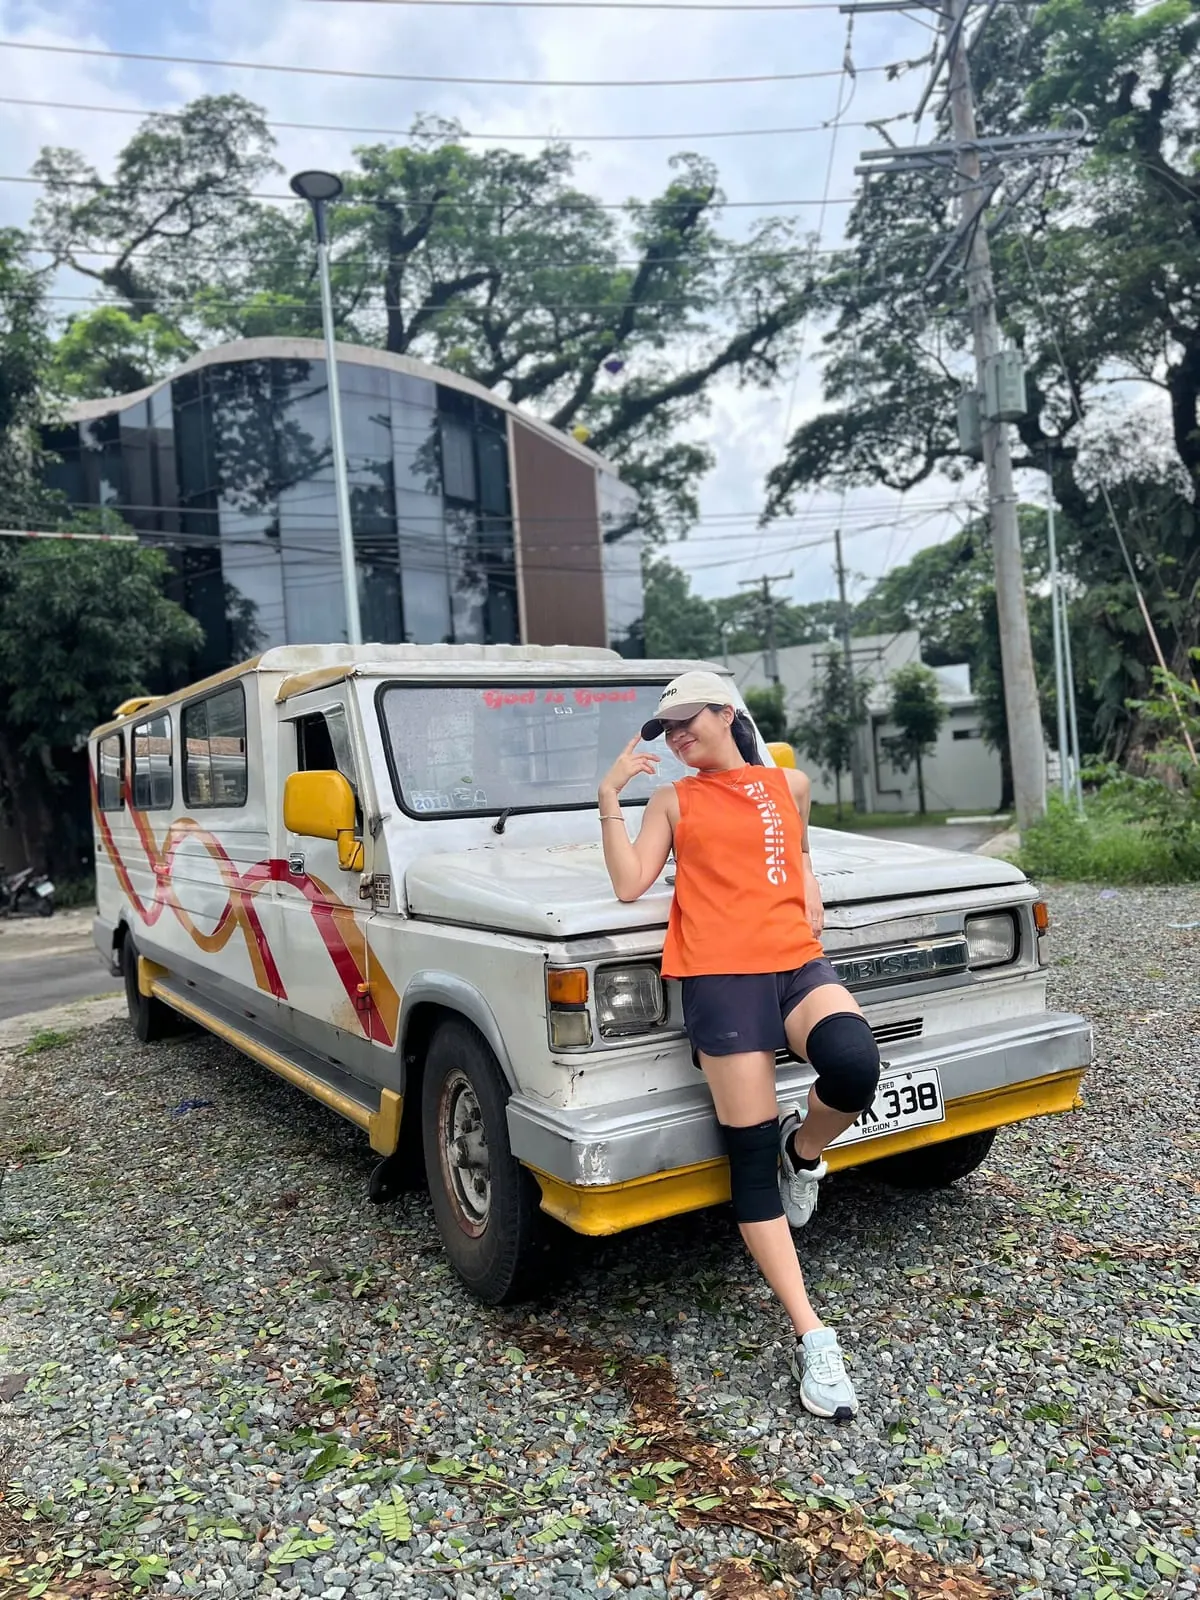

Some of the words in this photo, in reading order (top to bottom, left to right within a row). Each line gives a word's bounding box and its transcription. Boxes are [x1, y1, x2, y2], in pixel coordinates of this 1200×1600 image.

[482, 689, 536, 709] God
[573, 688, 637, 708] Good
[660, 687, 678, 702] eep
[876, 1081, 895, 1091] ERED
[882, 1082, 939, 1119] 338
[862, 1121, 890, 1135] REGION
[893, 1119, 899, 1127] 3
